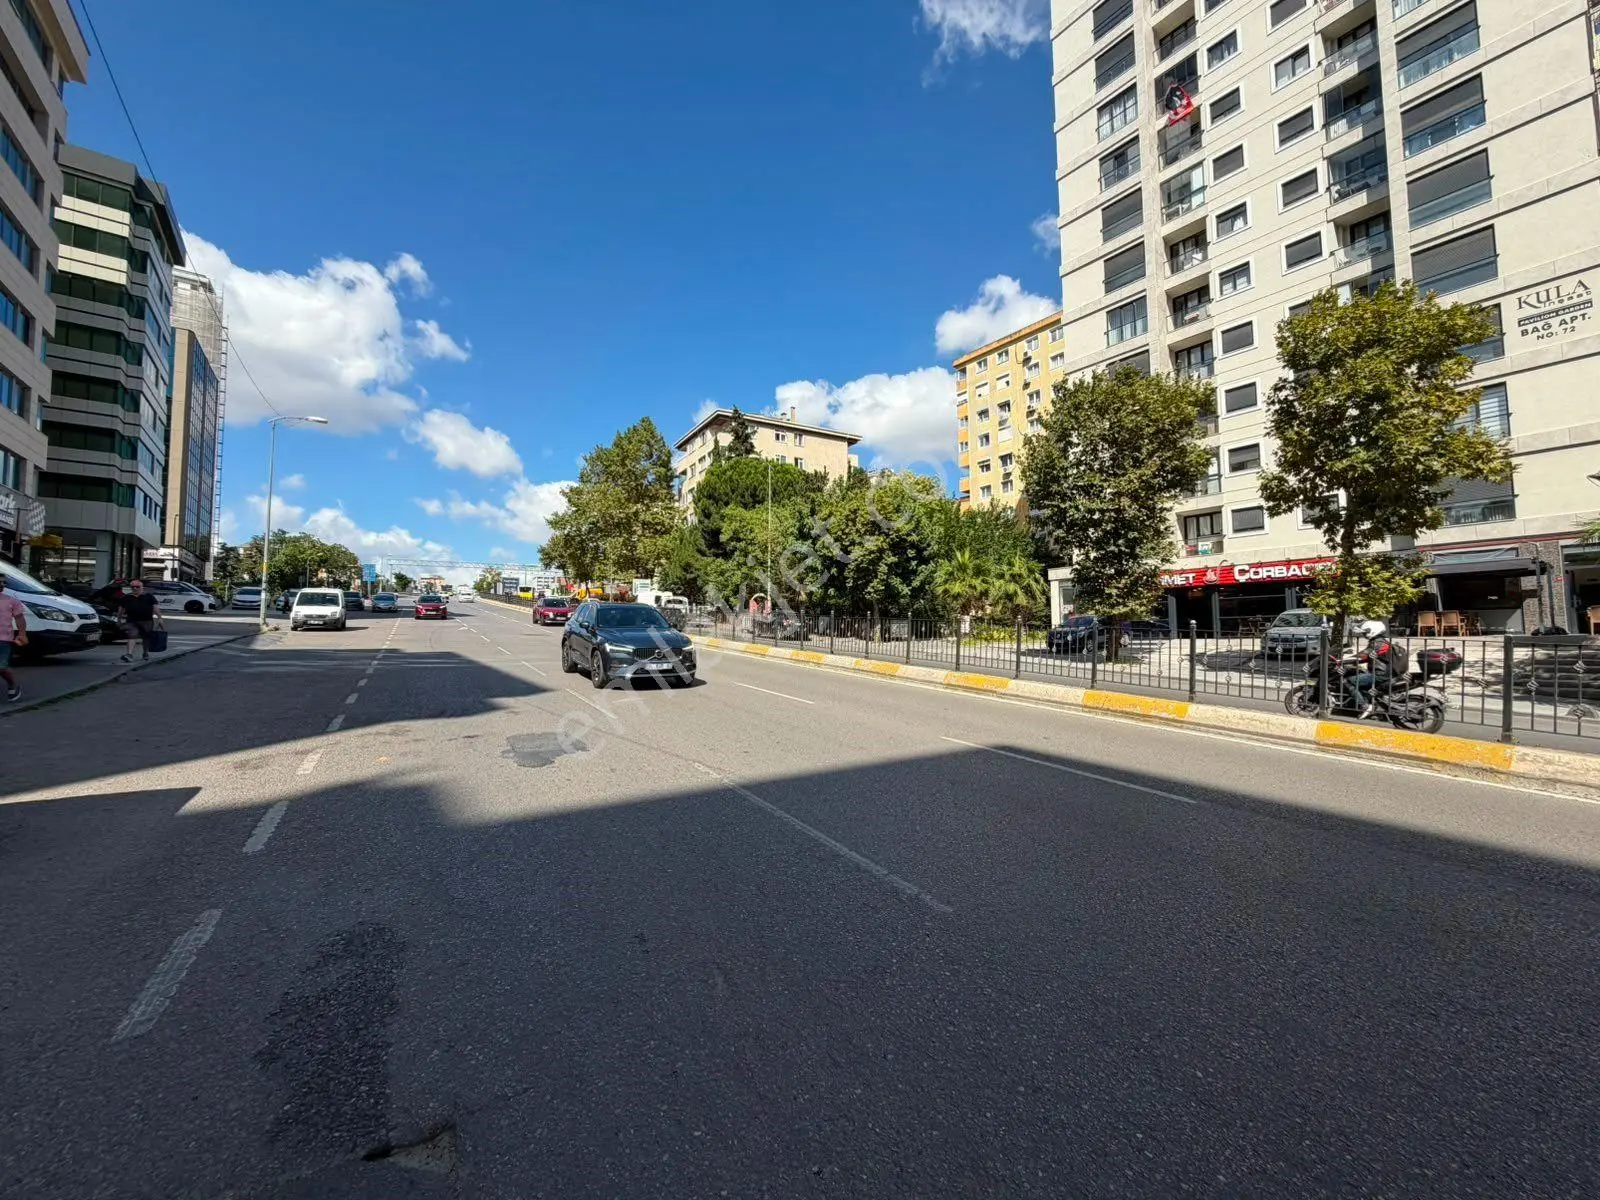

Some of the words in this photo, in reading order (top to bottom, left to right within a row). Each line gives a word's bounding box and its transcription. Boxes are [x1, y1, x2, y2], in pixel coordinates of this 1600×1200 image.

[1516, 279, 1591, 311] KULA
[1520, 321, 1553, 337] BAĞ
[1558, 312, 1592, 327] APT.
[1561, 326, 1576, 335] 72
